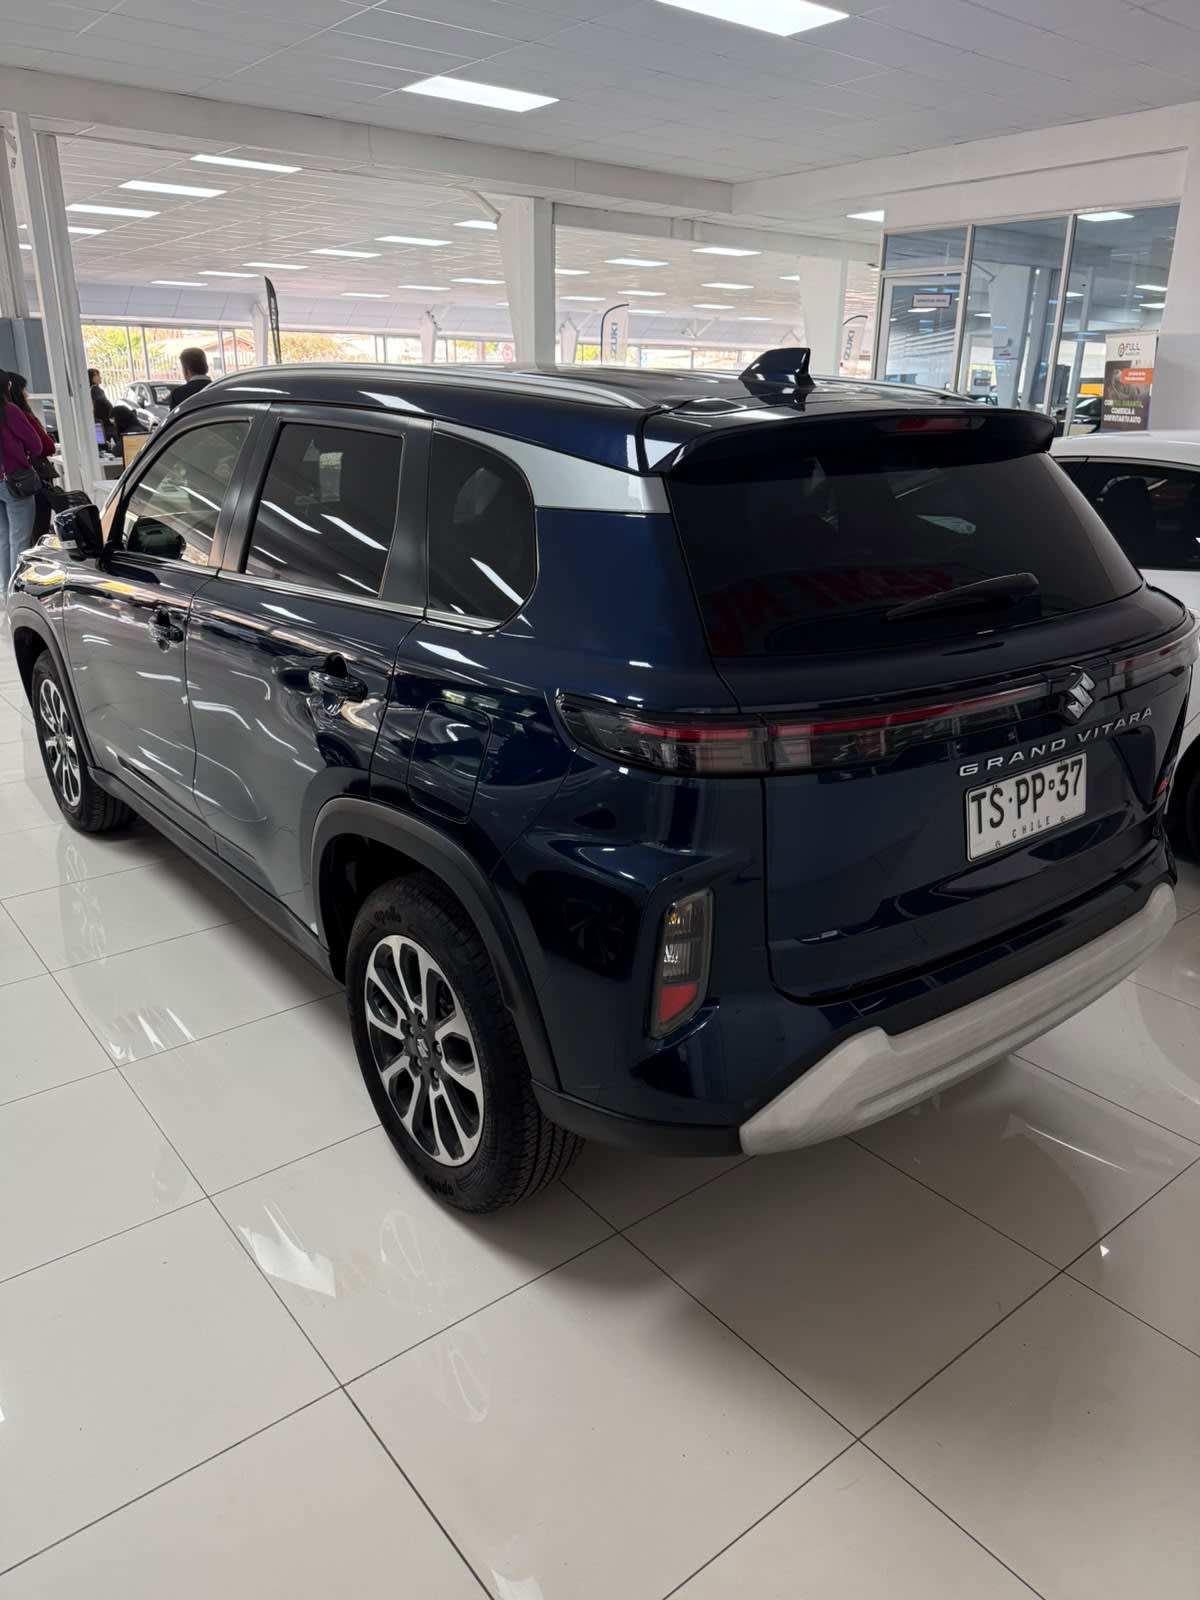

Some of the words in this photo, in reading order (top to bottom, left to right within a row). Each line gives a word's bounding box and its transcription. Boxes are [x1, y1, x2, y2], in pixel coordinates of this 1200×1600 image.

[959, 738, 1067, 777] GRAND
[1077, 707, 1152, 743] VITARA
[1011, 815, 1051, 839] CHILE
